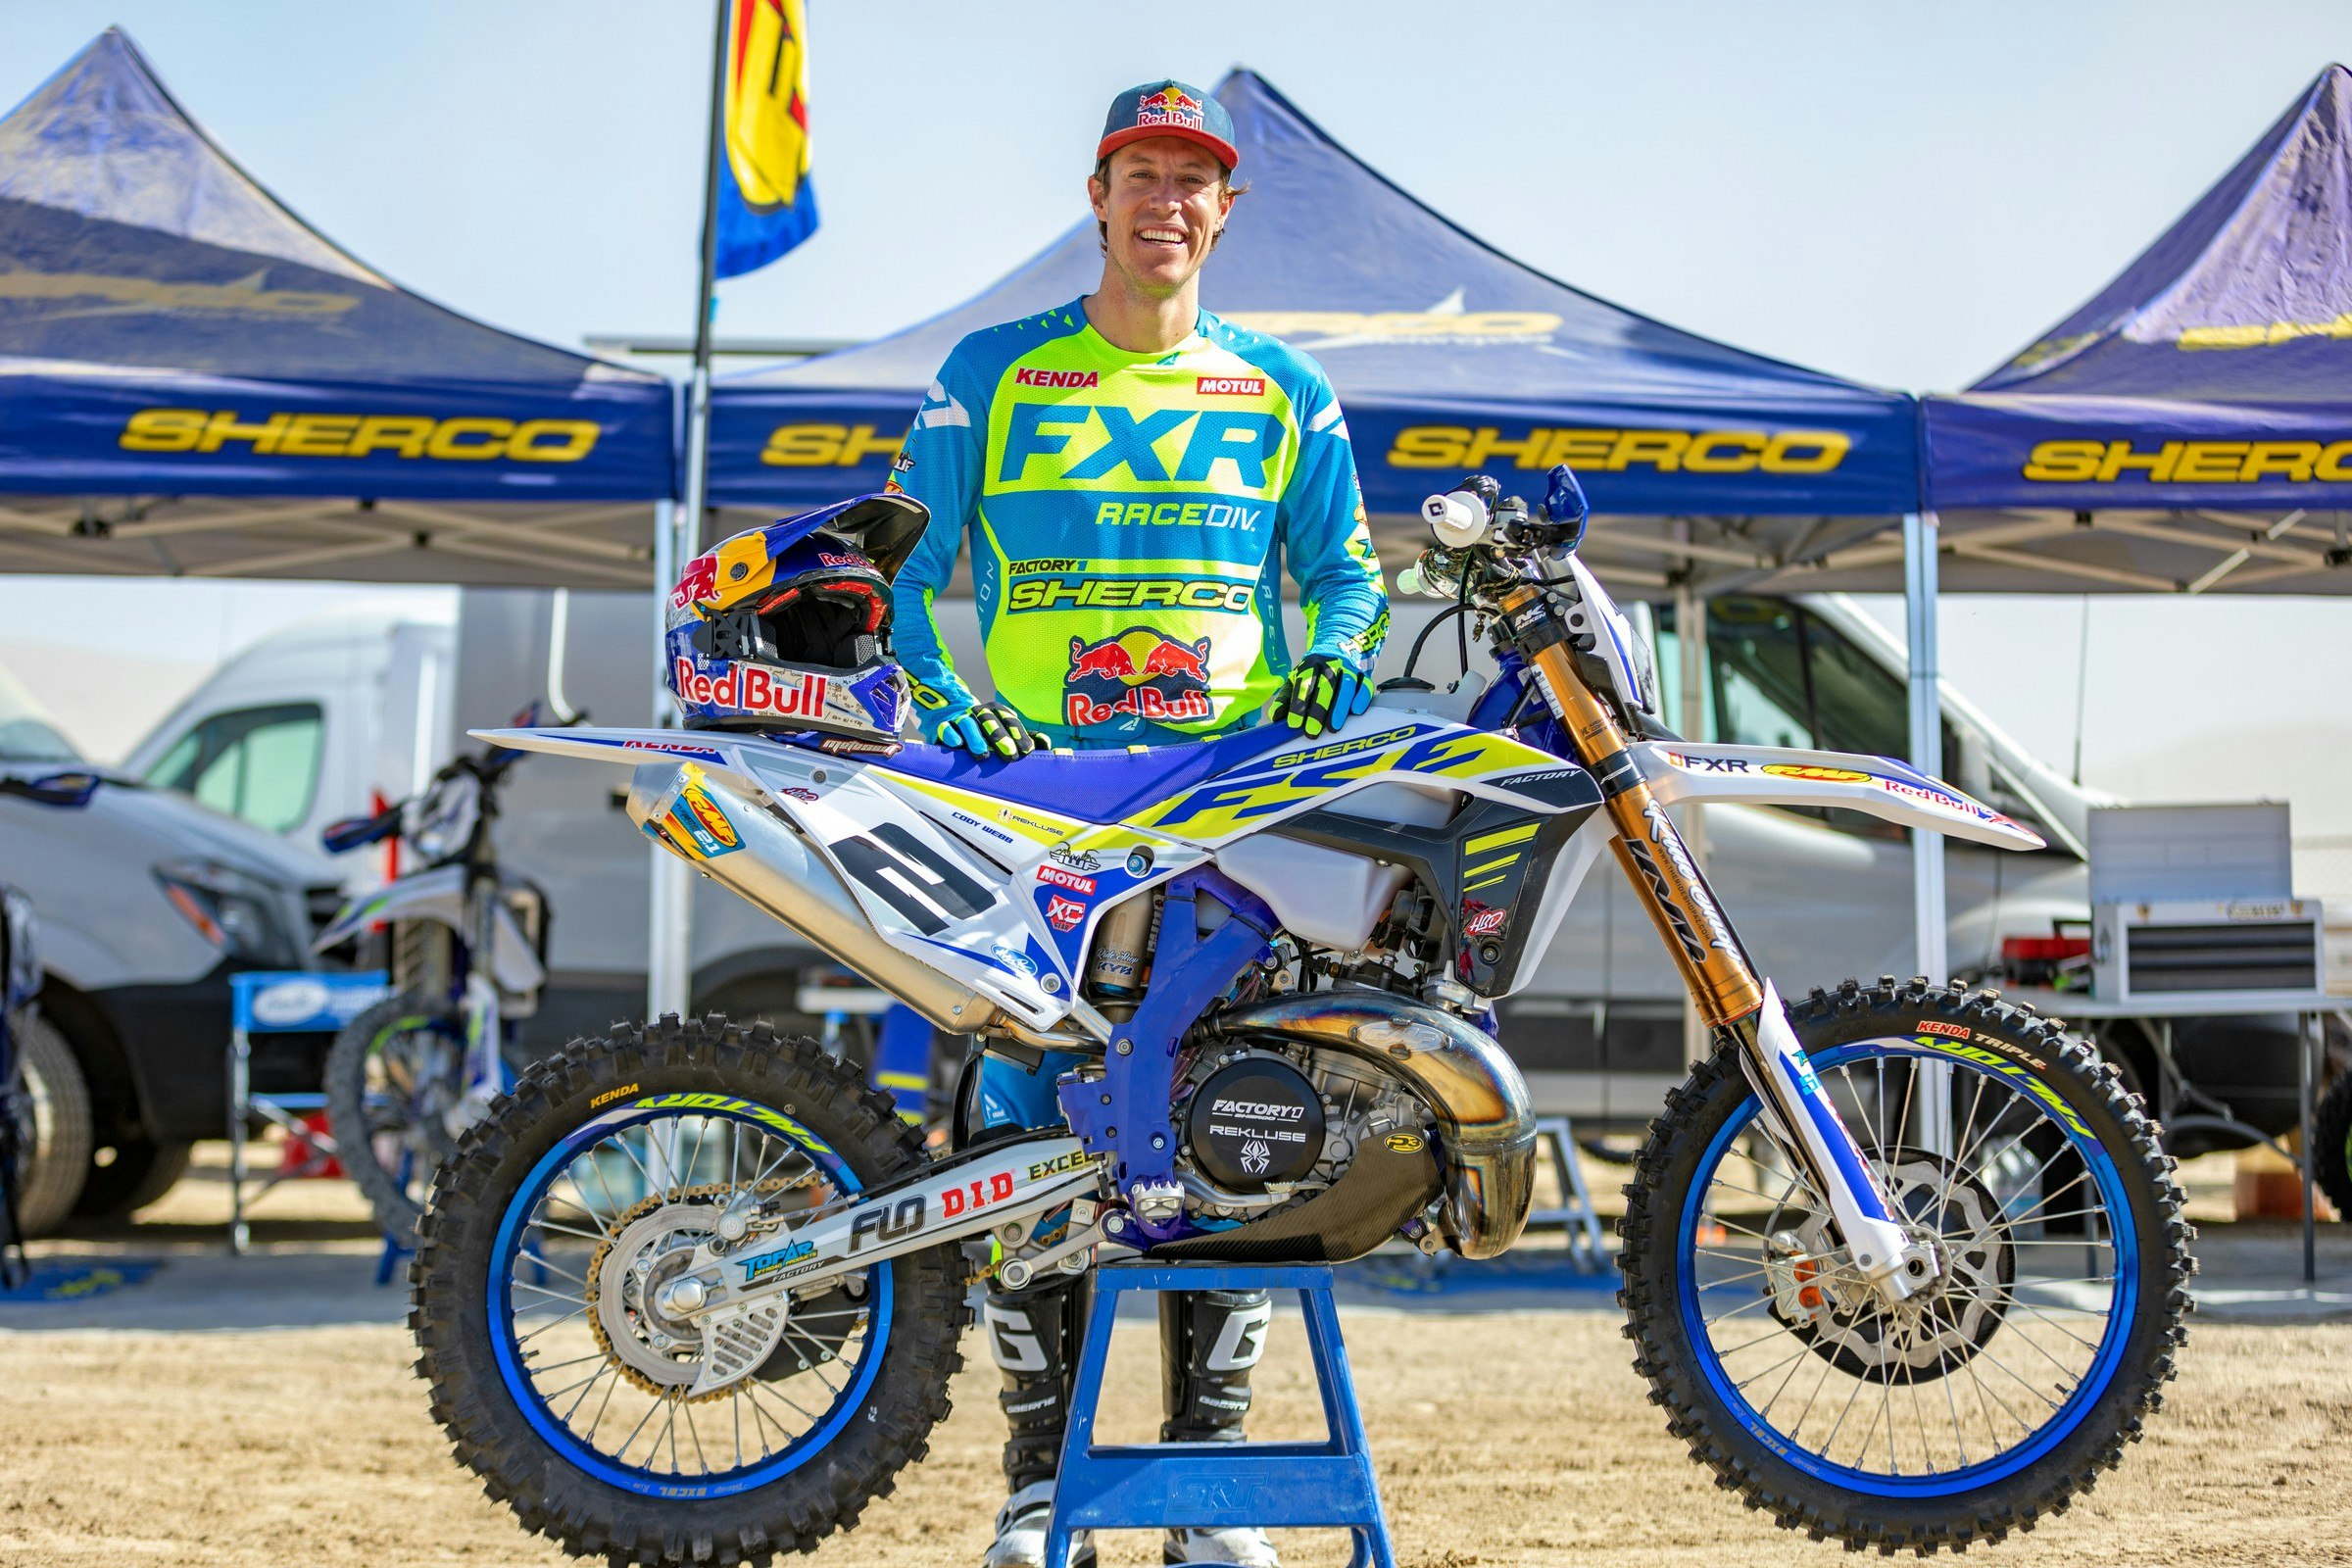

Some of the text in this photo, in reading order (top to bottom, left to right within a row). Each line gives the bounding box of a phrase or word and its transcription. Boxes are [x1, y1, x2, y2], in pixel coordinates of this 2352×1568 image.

[1138, 113, 1202, 129] Red Bull
[1015, 368, 1099, 388] KENDA
[1200, 379, 1262, 393] MOTUL
[119, 409, 601, 461] SHERCO
[999, 403, 1286, 489] FXR
[1387, 426, 1851, 473] SHERCO
[1008, 578, 1255, 612] SHERCO
[676, 658, 739, 709] Red
[742, 667, 829, 718] Bull
[1068, 686, 1209, 726] Red Bull
[1273, 725, 1416, 768] SHERCO
[1500, 769, 1582, 787] FACTORY
[1685, 757, 1748, 773] FXR
[1765, 764, 1870, 782] FMF
[1886, 780, 1980, 815] Red Bull
[952, 811, 1013, 844] CODY WEBB
[1011, 815, 1064, 837] REKLUSE
[828, 822, 996, 937] 2
[1040, 868, 1094, 894] MOTUL
[1097, 961, 1133, 976] KYB
[1916, 1021, 2046, 1070] KENDA TRIPLE
[590, 1082, 639, 1109] KENDA
[1209, 1124, 1306, 1144] REKLUSE
[735, 1238, 814, 1282] TOPAR
[772, 1260, 824, 1283] FACTORY
[785, 1251, 818, 1266] PRODUCTS
